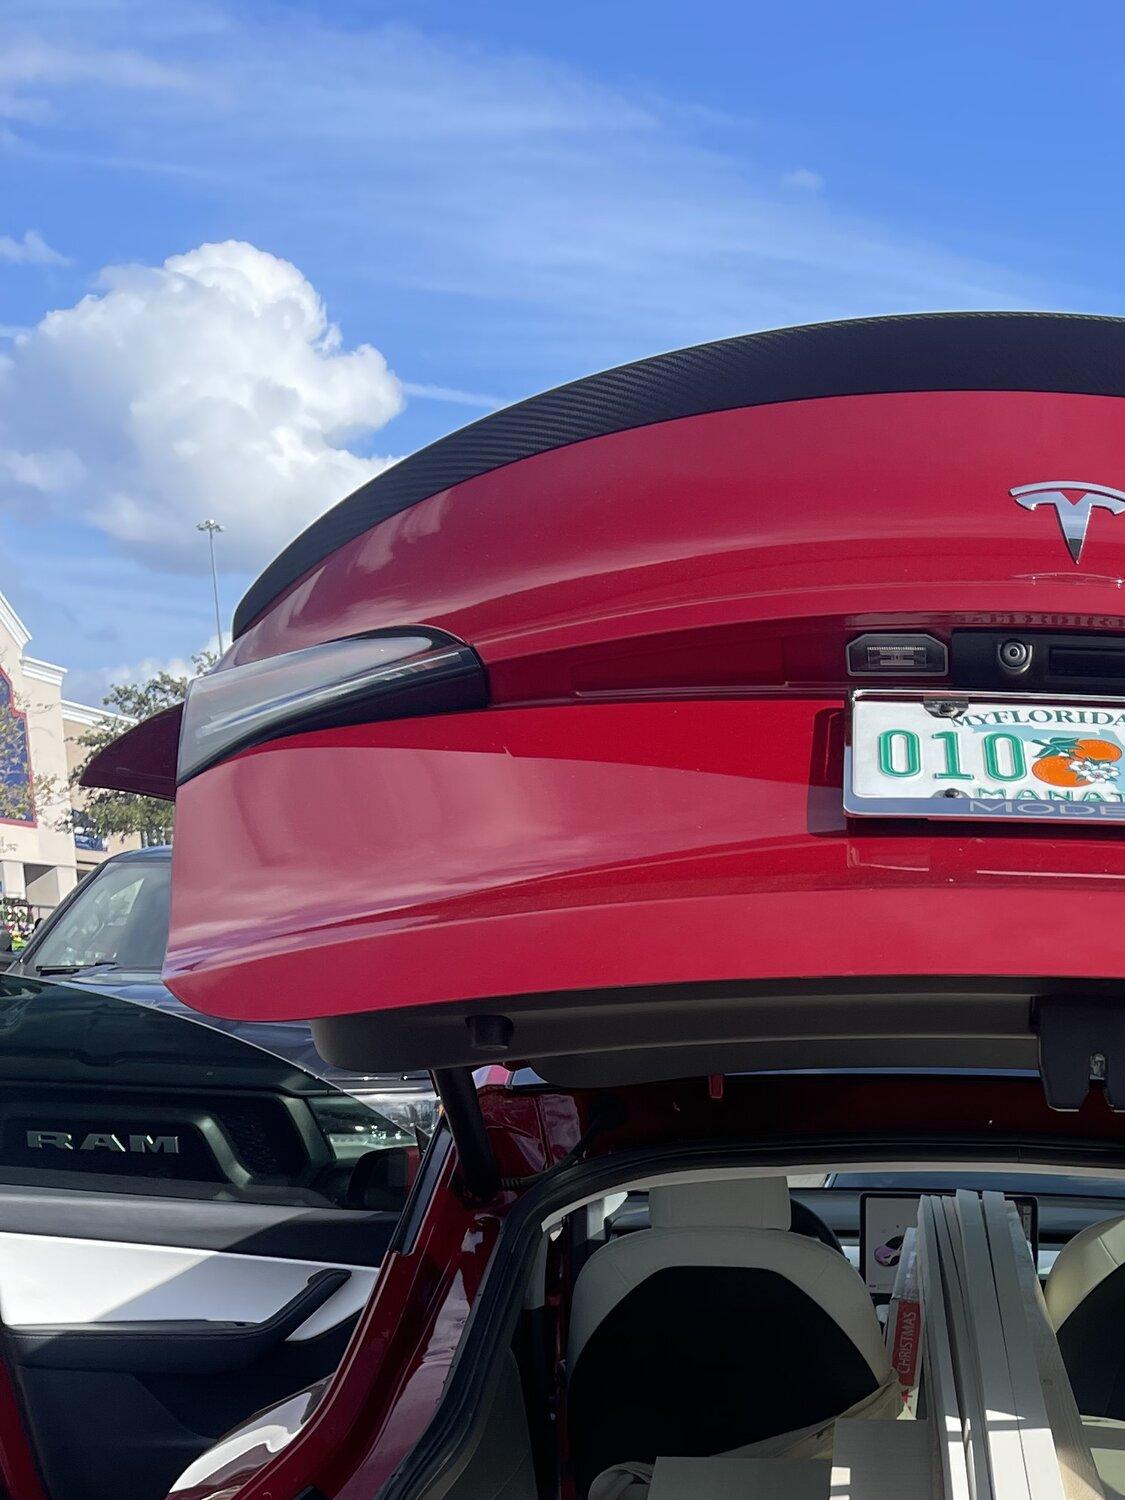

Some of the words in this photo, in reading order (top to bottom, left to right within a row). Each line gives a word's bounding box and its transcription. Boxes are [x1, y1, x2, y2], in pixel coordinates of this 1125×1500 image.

[878, 729, 1028, 782] 010
[26, 1130, 180, 1154] RAM
[896, 1310, 916, 1374] CHRISTMAS
